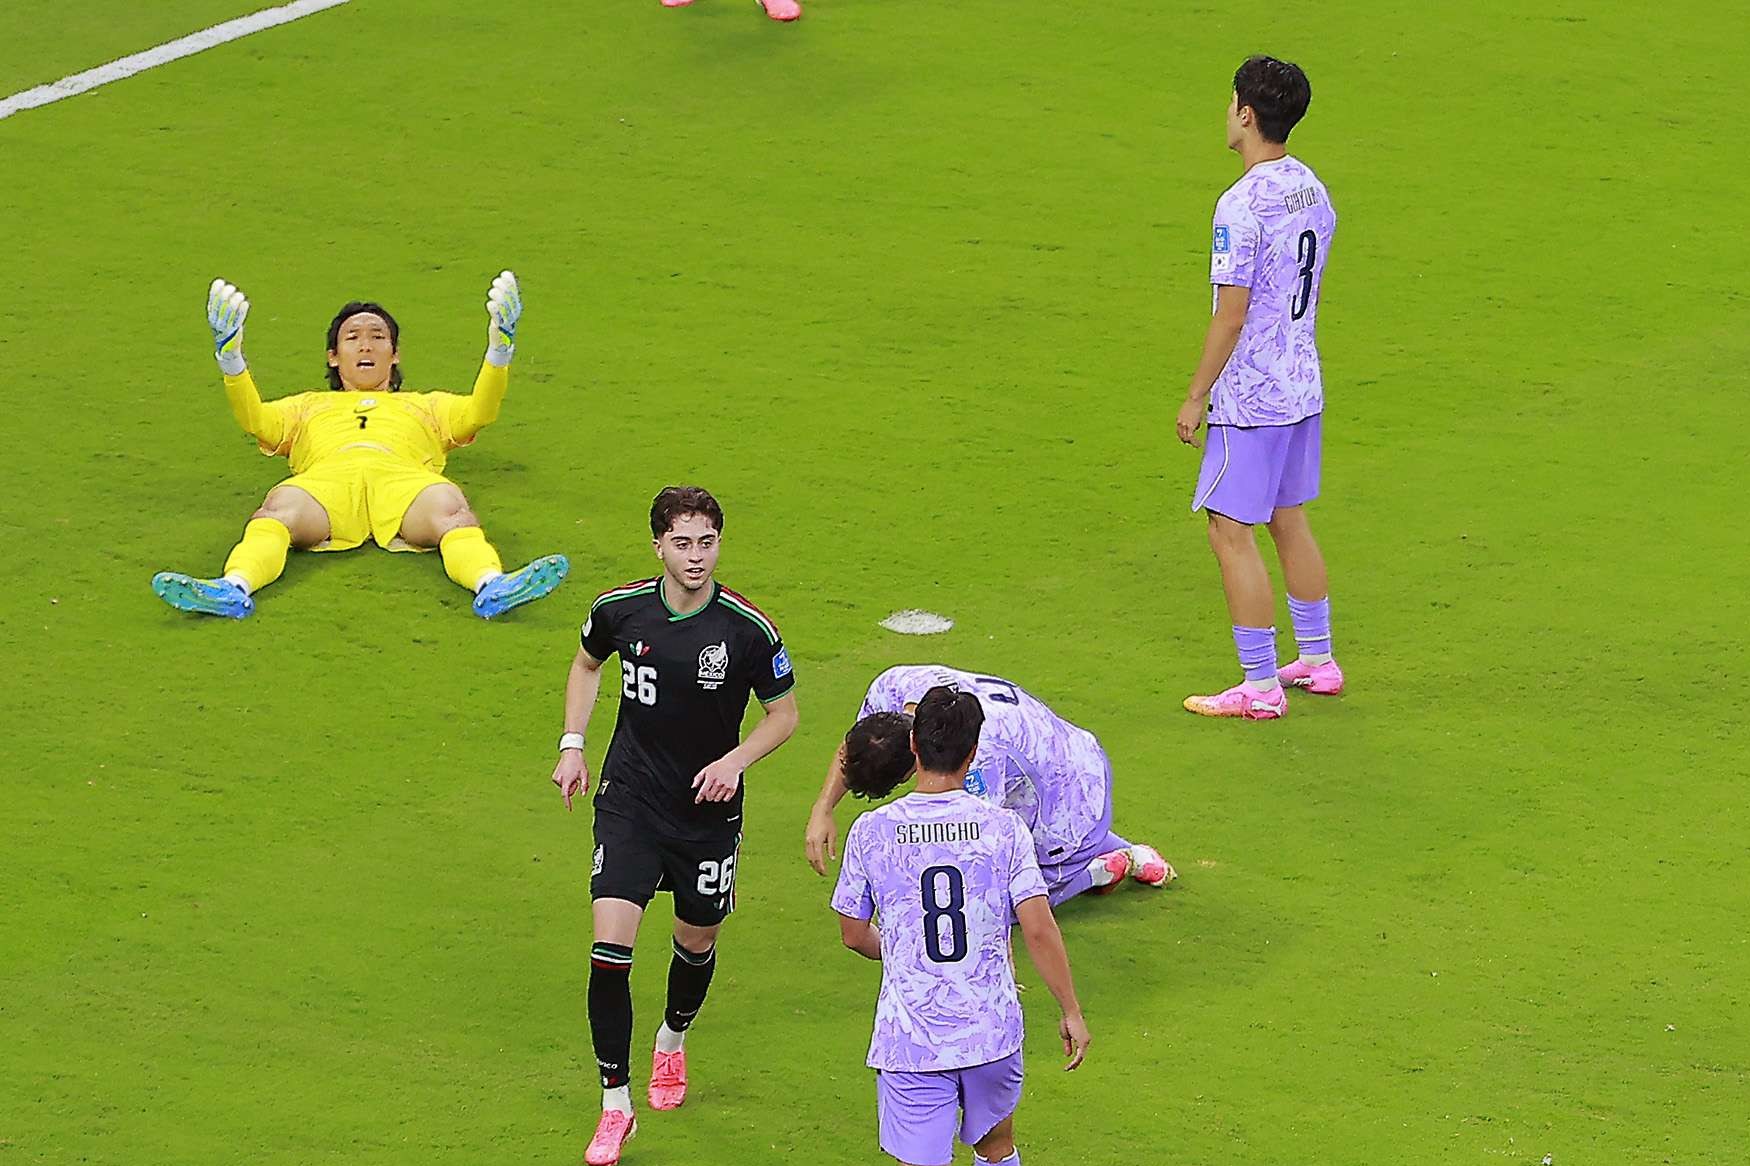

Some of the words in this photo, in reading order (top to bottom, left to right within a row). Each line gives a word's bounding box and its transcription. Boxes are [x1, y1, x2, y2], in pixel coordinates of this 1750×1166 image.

[1291, 229, 1316, 321] 3
[623, 660, 657, 706] 26
[896, 821, 980, 844] SEUNGHO
[697, 855, 733, 895] 26
[920, 864, 968, 963] 8
